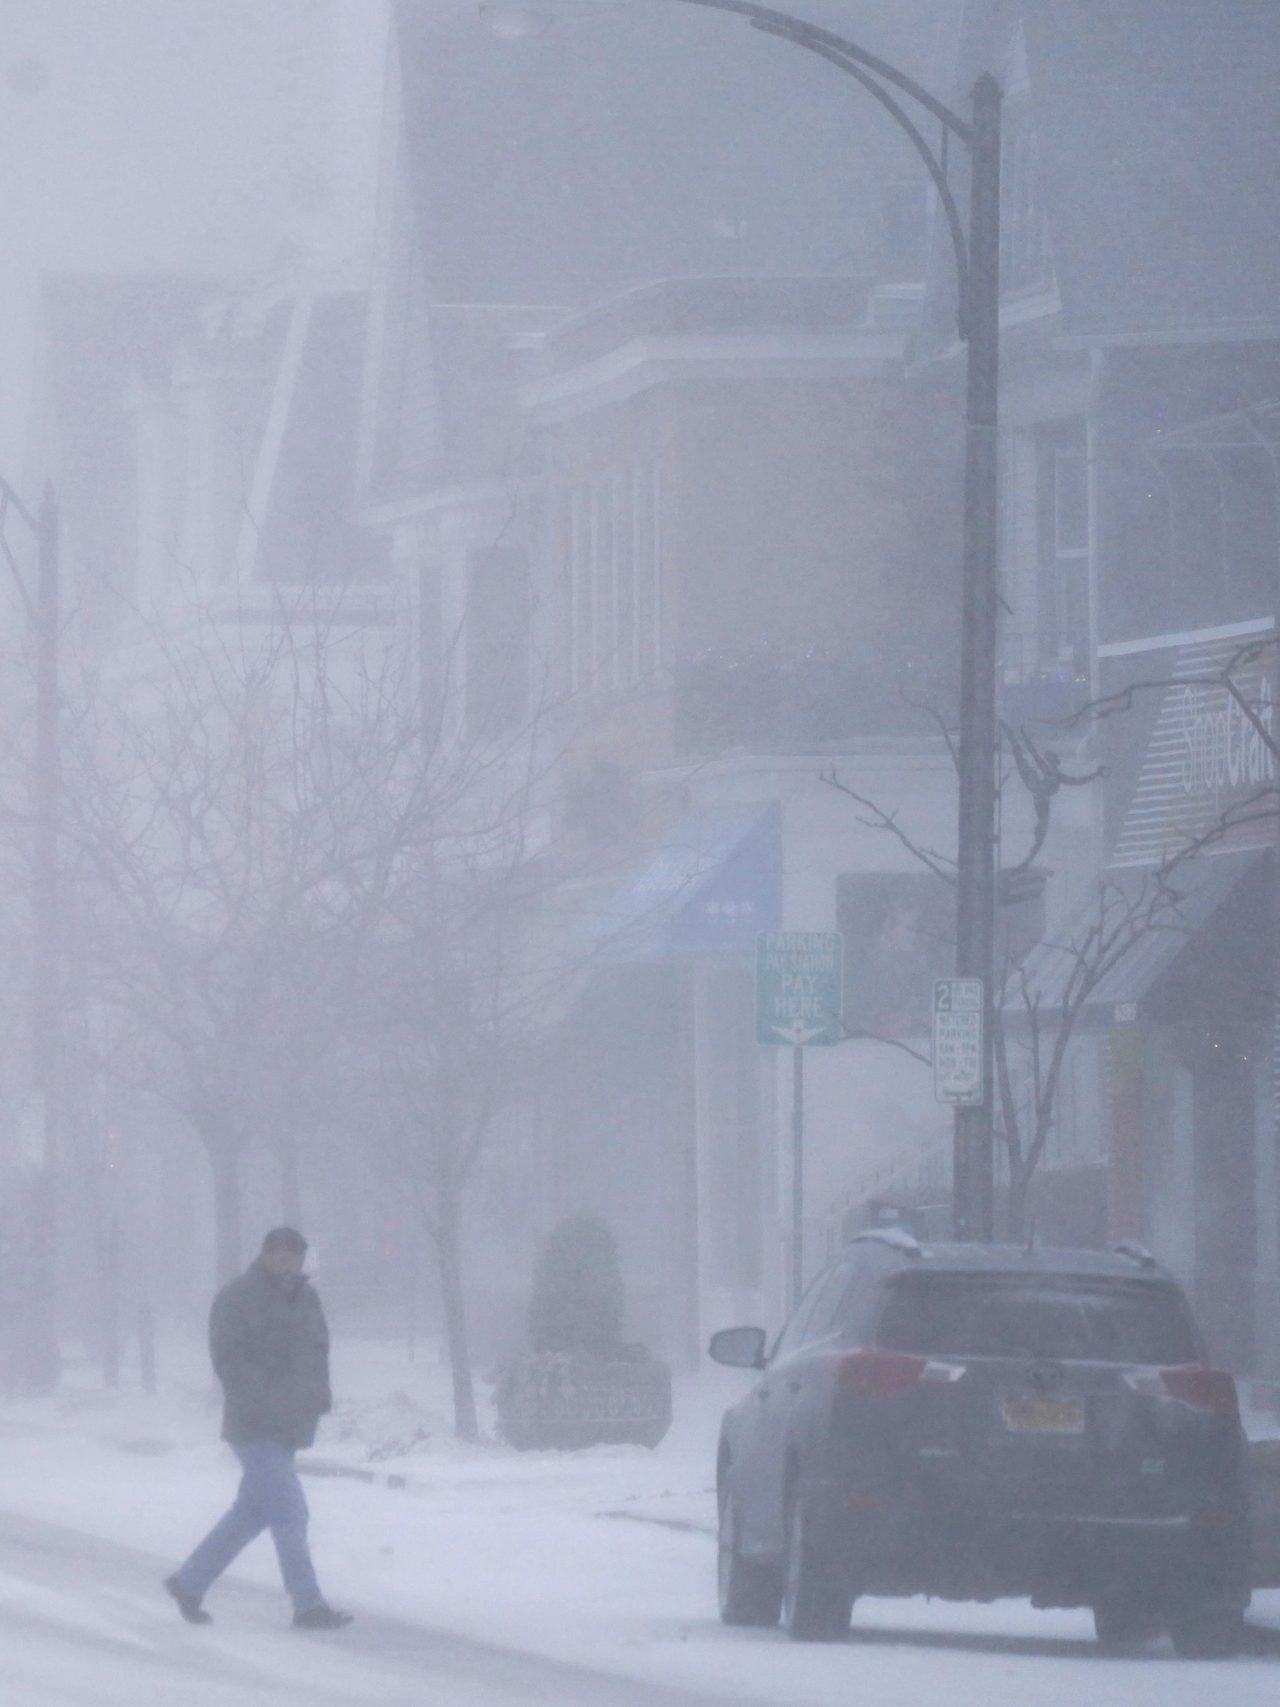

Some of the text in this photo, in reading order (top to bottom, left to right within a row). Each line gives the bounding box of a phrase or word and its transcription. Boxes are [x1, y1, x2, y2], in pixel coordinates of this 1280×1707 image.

[765, 933, 835, 952] PARKING
[781, 974, 817, 995] PAY
[774, 996, 825, 1019] HERE
[937, 983, 950, 1010] 2
